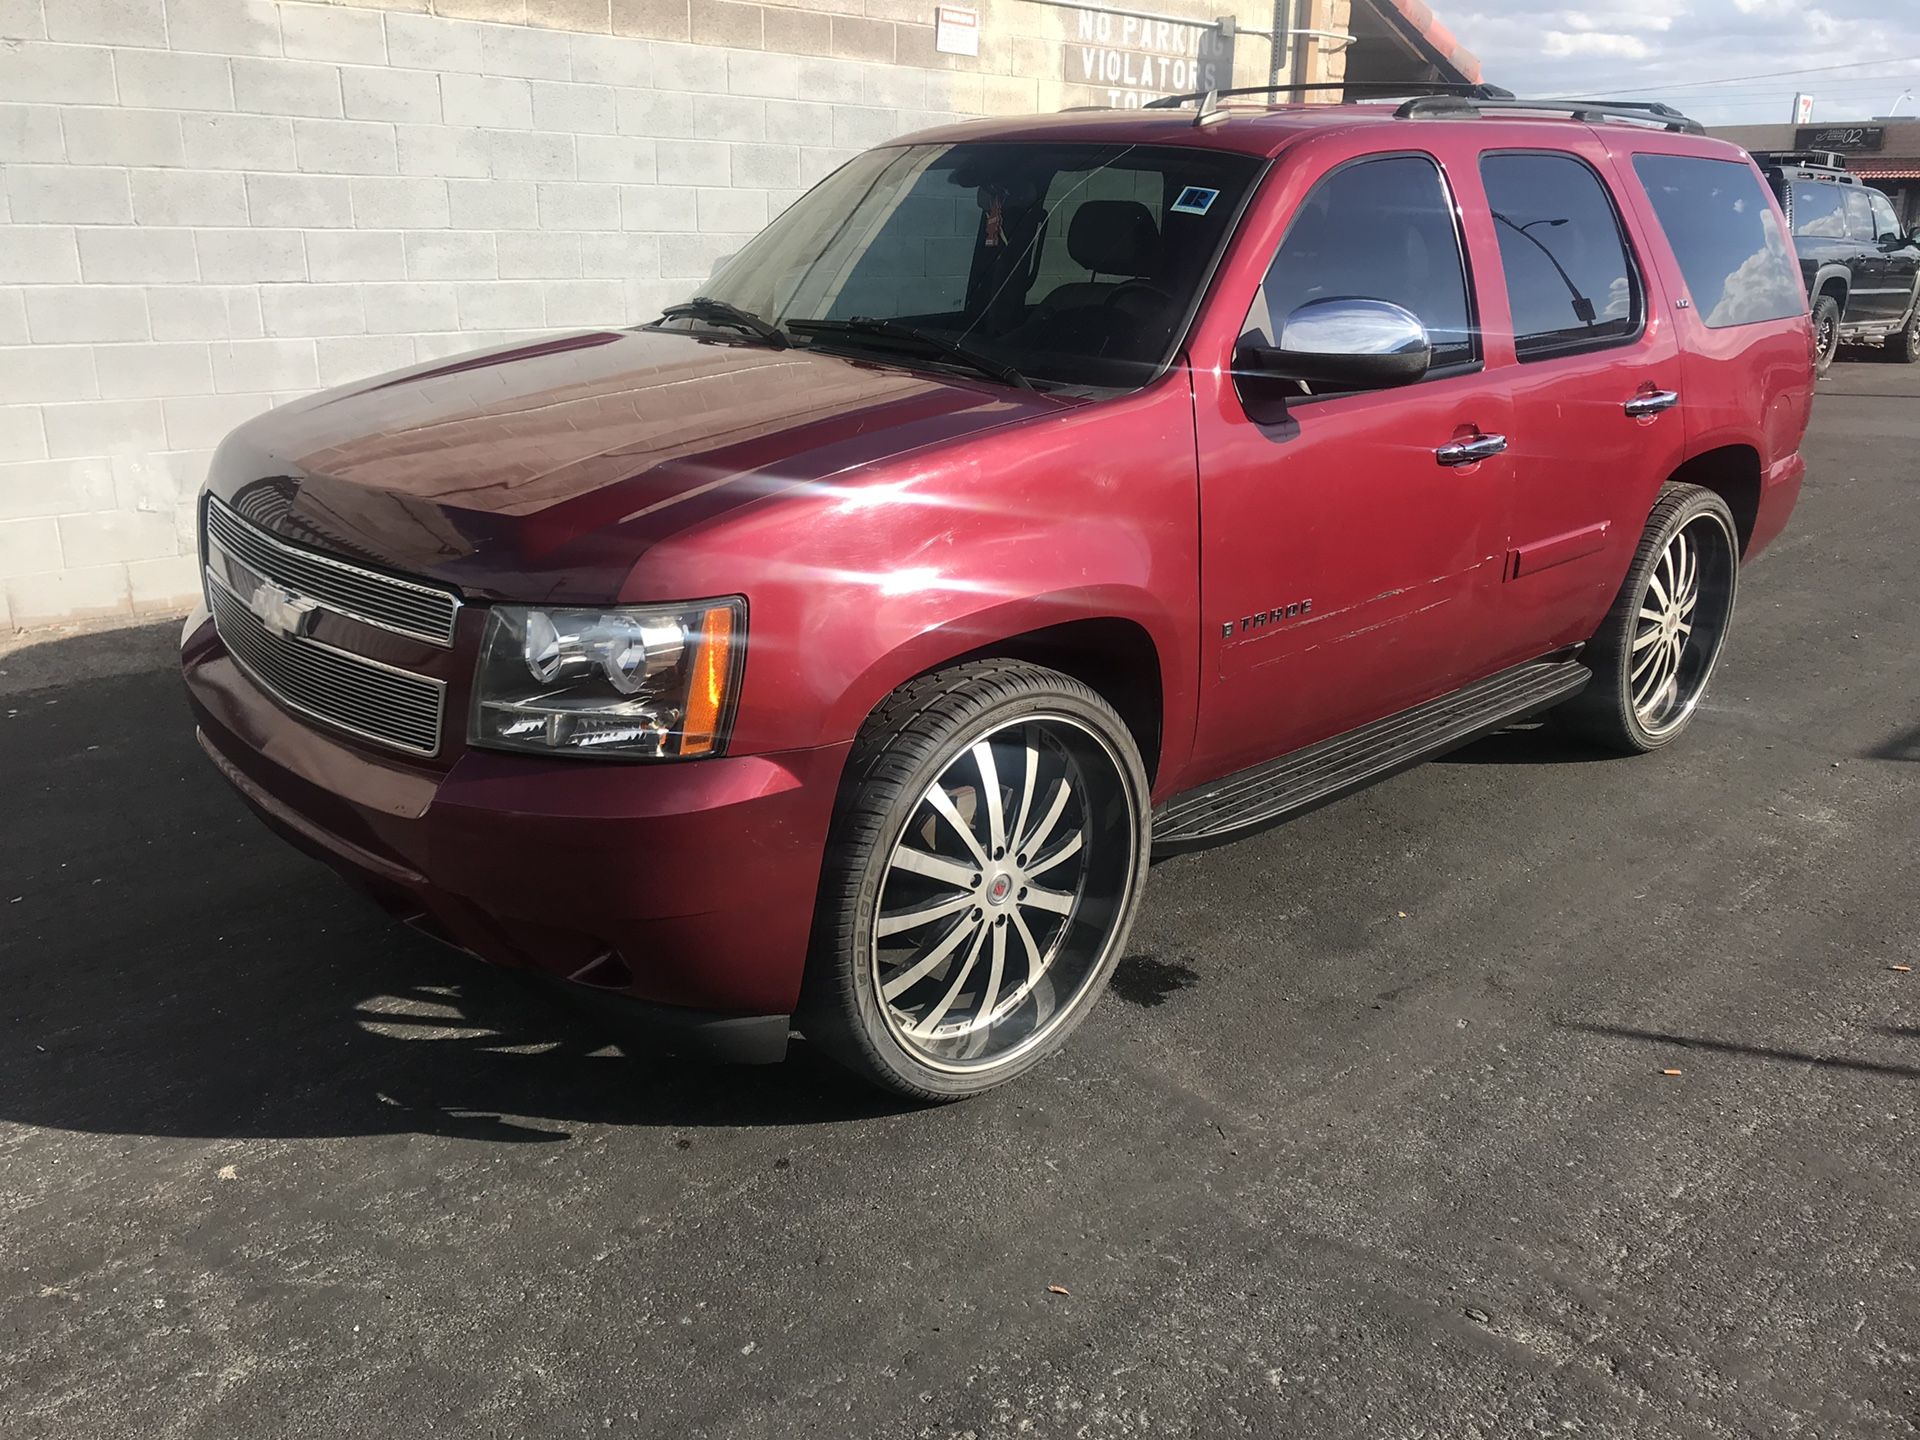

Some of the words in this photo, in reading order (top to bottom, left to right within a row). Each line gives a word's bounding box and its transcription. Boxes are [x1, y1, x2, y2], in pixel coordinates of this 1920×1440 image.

[1078, 9, 1111, 42] NO
[1123, 16, 1224, 57] PARKING
[1082, 47, 1216, 91] VIOLATORS
[1240, 598, 1313, 632] TAHOE
